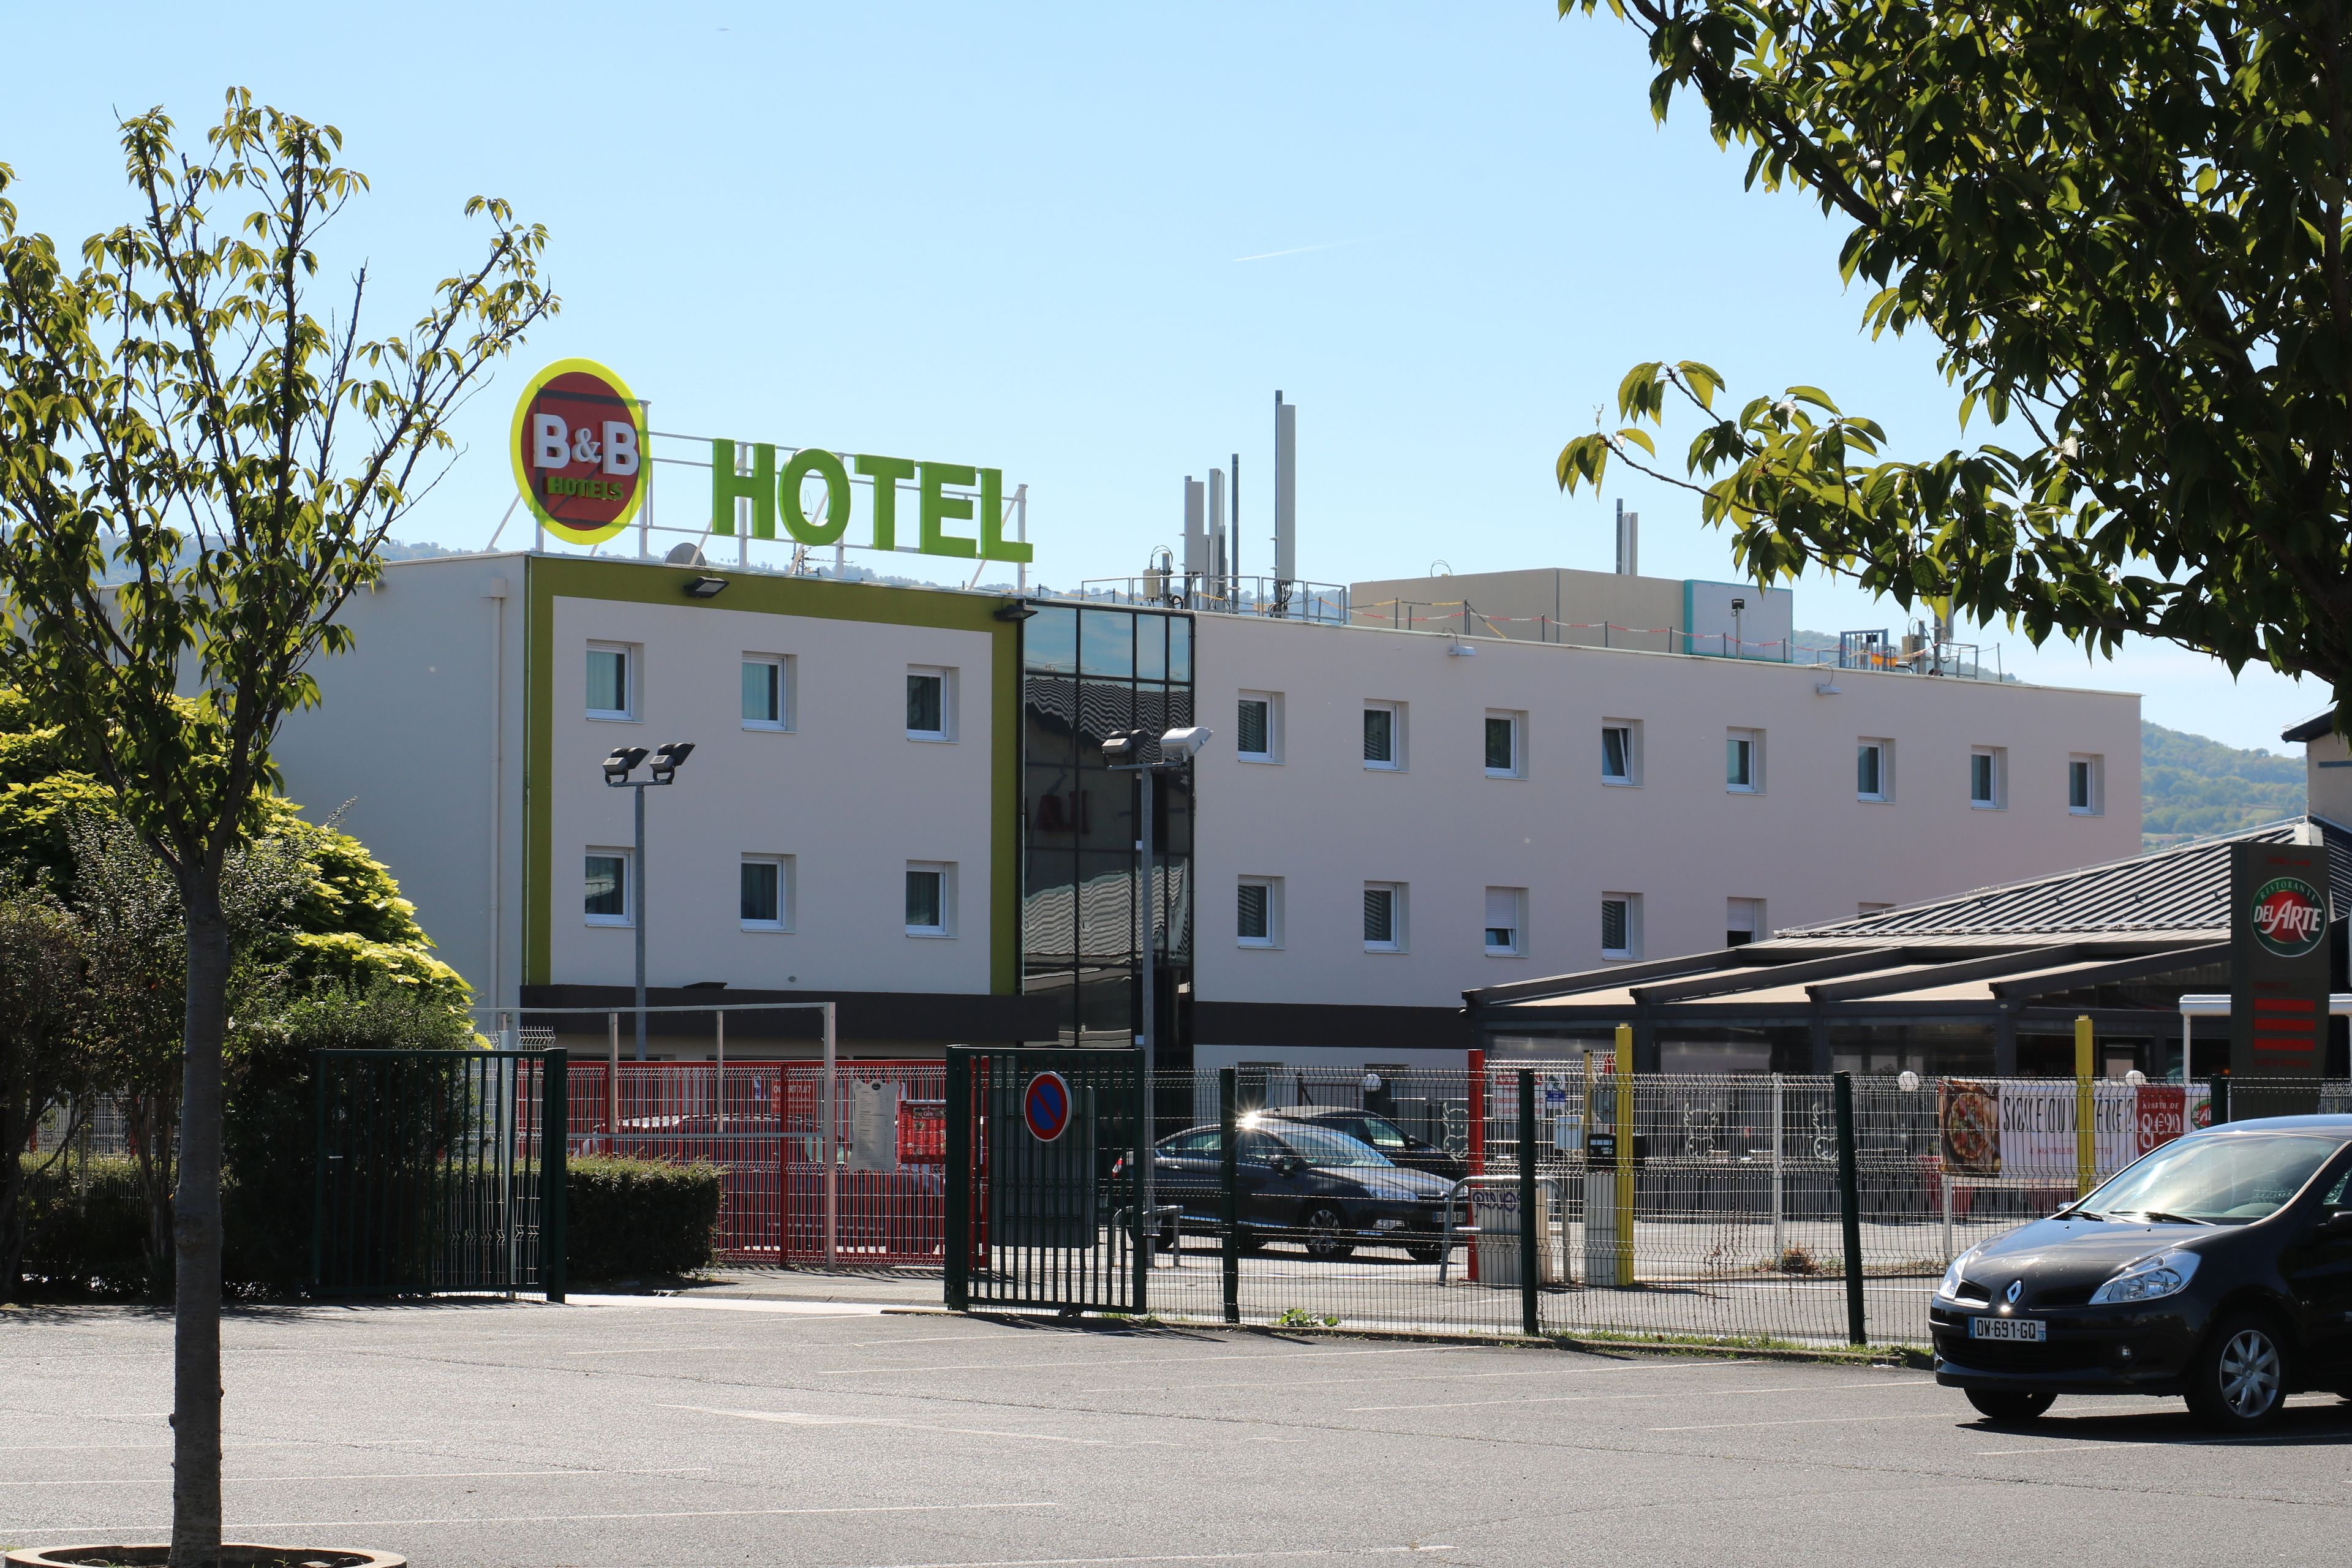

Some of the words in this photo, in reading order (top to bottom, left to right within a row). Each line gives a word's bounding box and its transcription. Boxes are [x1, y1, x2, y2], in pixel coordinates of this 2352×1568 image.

[533, 413, 639, 476] B&B
[548, 477, 624, 500] HOTELS
[712, 438, 1033, 563] HOTEL
[2261, 881, 2316, 902] RISTORANTE
[2048, 1098, 2065, 1133] OU
[1977, 1319, 2035, 1339] DW-691-GQ
[2039, 1332, 2046, 1340] 63
